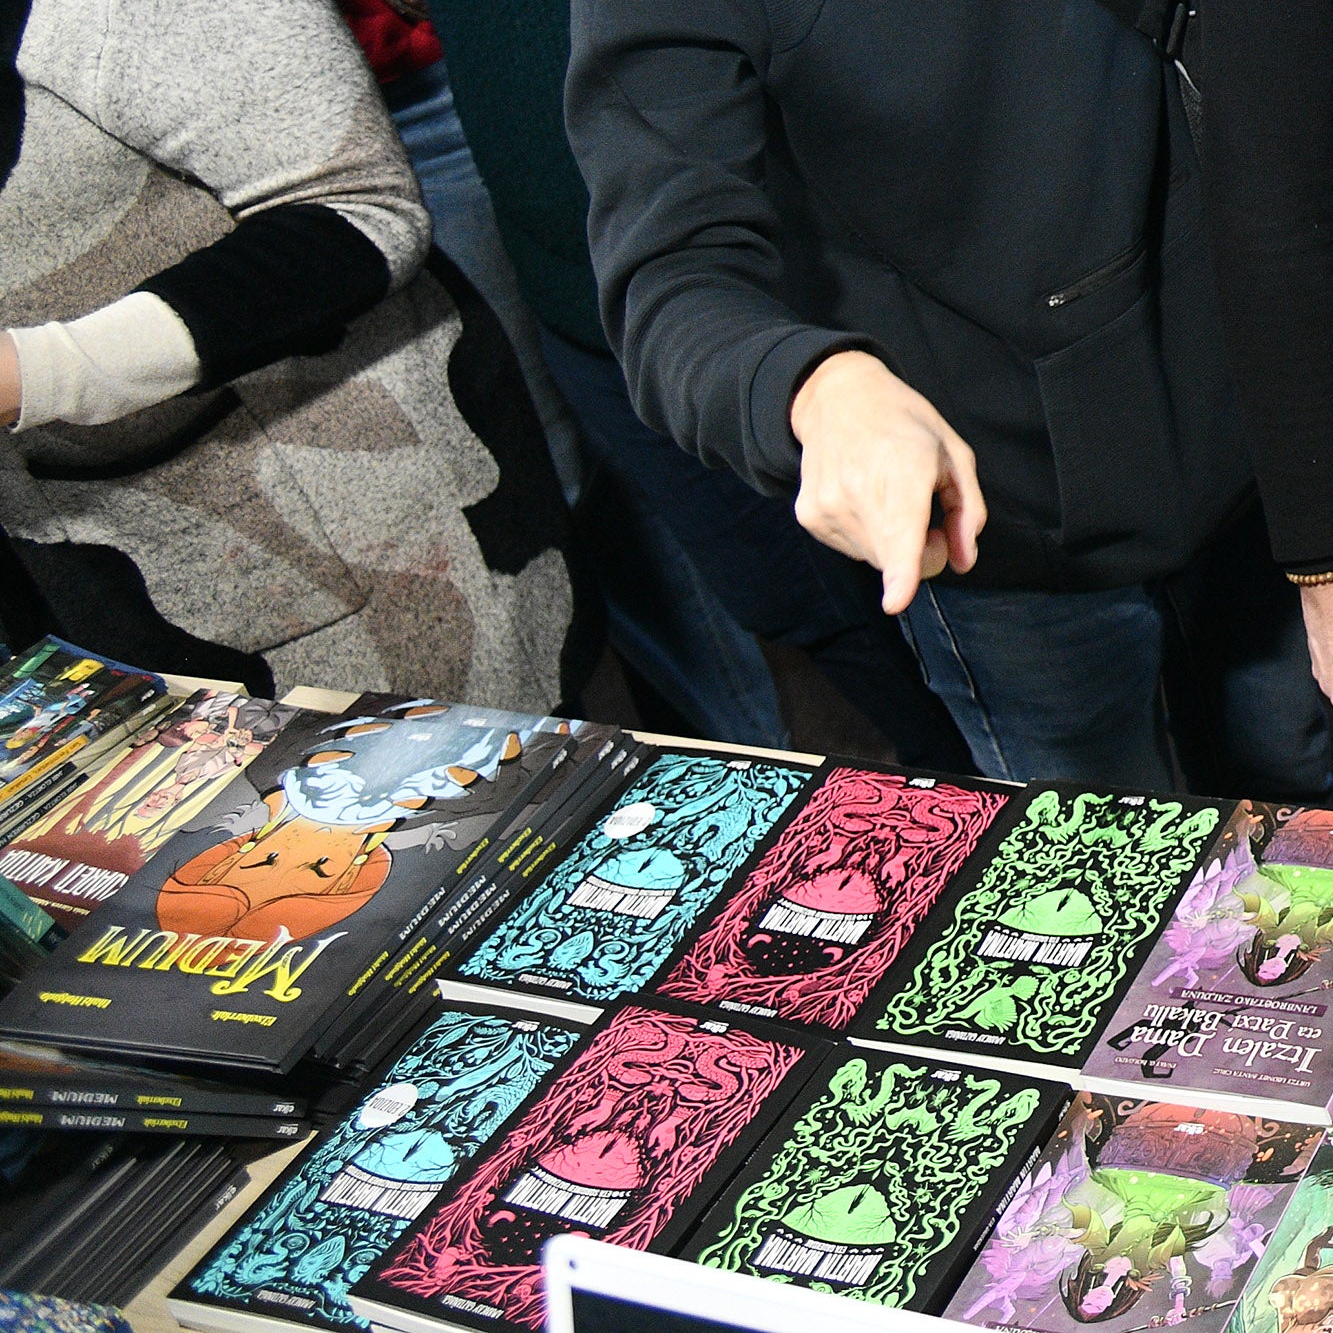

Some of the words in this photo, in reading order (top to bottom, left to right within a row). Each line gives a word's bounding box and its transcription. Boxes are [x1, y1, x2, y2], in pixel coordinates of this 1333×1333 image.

[438, 874, 487, 927] MEDIUM
[447, 882, 497, 934] MEDIUM
[566, 881, 626, 912] MARTINA
[612, 894, 674, 920] MARTIN
[399, 886, 446, 941] MEDIUM
[461, 889, 511, 941] MEDIUM
[759, 904, 821, 936] MARTINA
[811, 919, 872, 945] MARTIN
[977, 930, 1040, 961] MARTINA
[1032, 942, 1093, 967] MARTIN
[1142, 1003, 1223, 1032] Bakallu
[1228, 1013, 1296, 1040] Patxi
[1297, 1026, 1323, 1040] eta
[1128, 1025, 1215, 1057] Dama
[1221, 1036, 1322, 1074] Itzalen
[52, 1090, 120, 1105] MEDIUM
[60, 1114, 126, 1127] MEDIUM
[1019, 1146, 1042, 1181] MARTIN
[319, 1172, 386, 1209] MARTINA
[369, 1187, 439, 1221] MARTIN
[504, 1173, 573, 1216] MARTINA
[995, 1176, 1021, 1216] MARTINA
[559, 1194, 629, 1229] MARTIN
[752, 1234, 825, 1276] MARTINA
[812, 1253, 884, 1285] MARTIN
